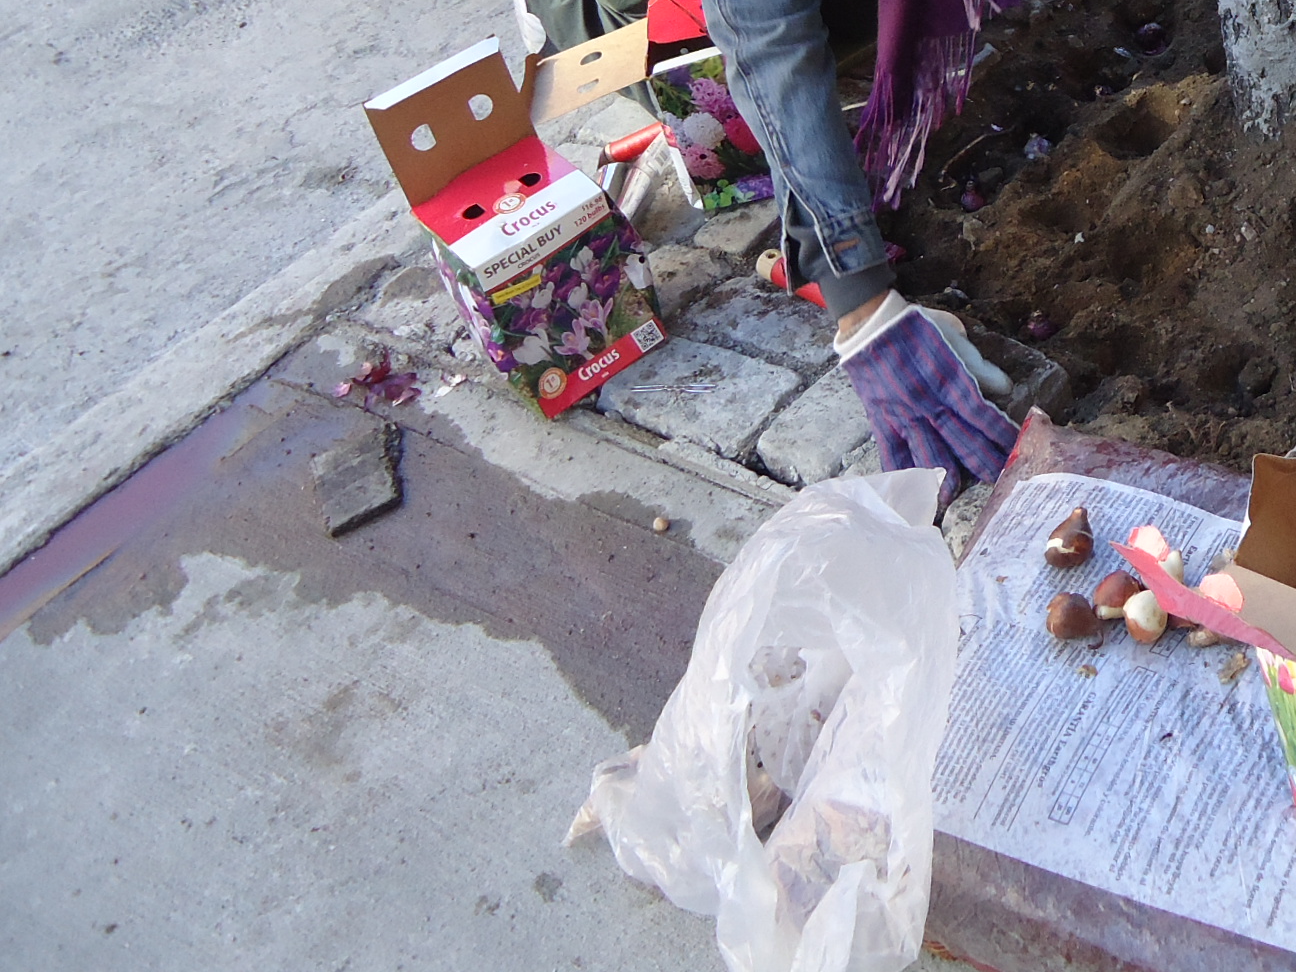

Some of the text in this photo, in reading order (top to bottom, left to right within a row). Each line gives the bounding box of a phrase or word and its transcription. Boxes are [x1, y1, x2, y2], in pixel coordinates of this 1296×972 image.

[501, 201, 556, 236] Crocus
[483, 244, 537, 278] SPECIAL
[537, 224, 562, 247] BUY
[574, 216, 586, 227] 120
[578, 349, 620, 381] Crocus
[1061, 688, 1097, 741] GARANTÍA
